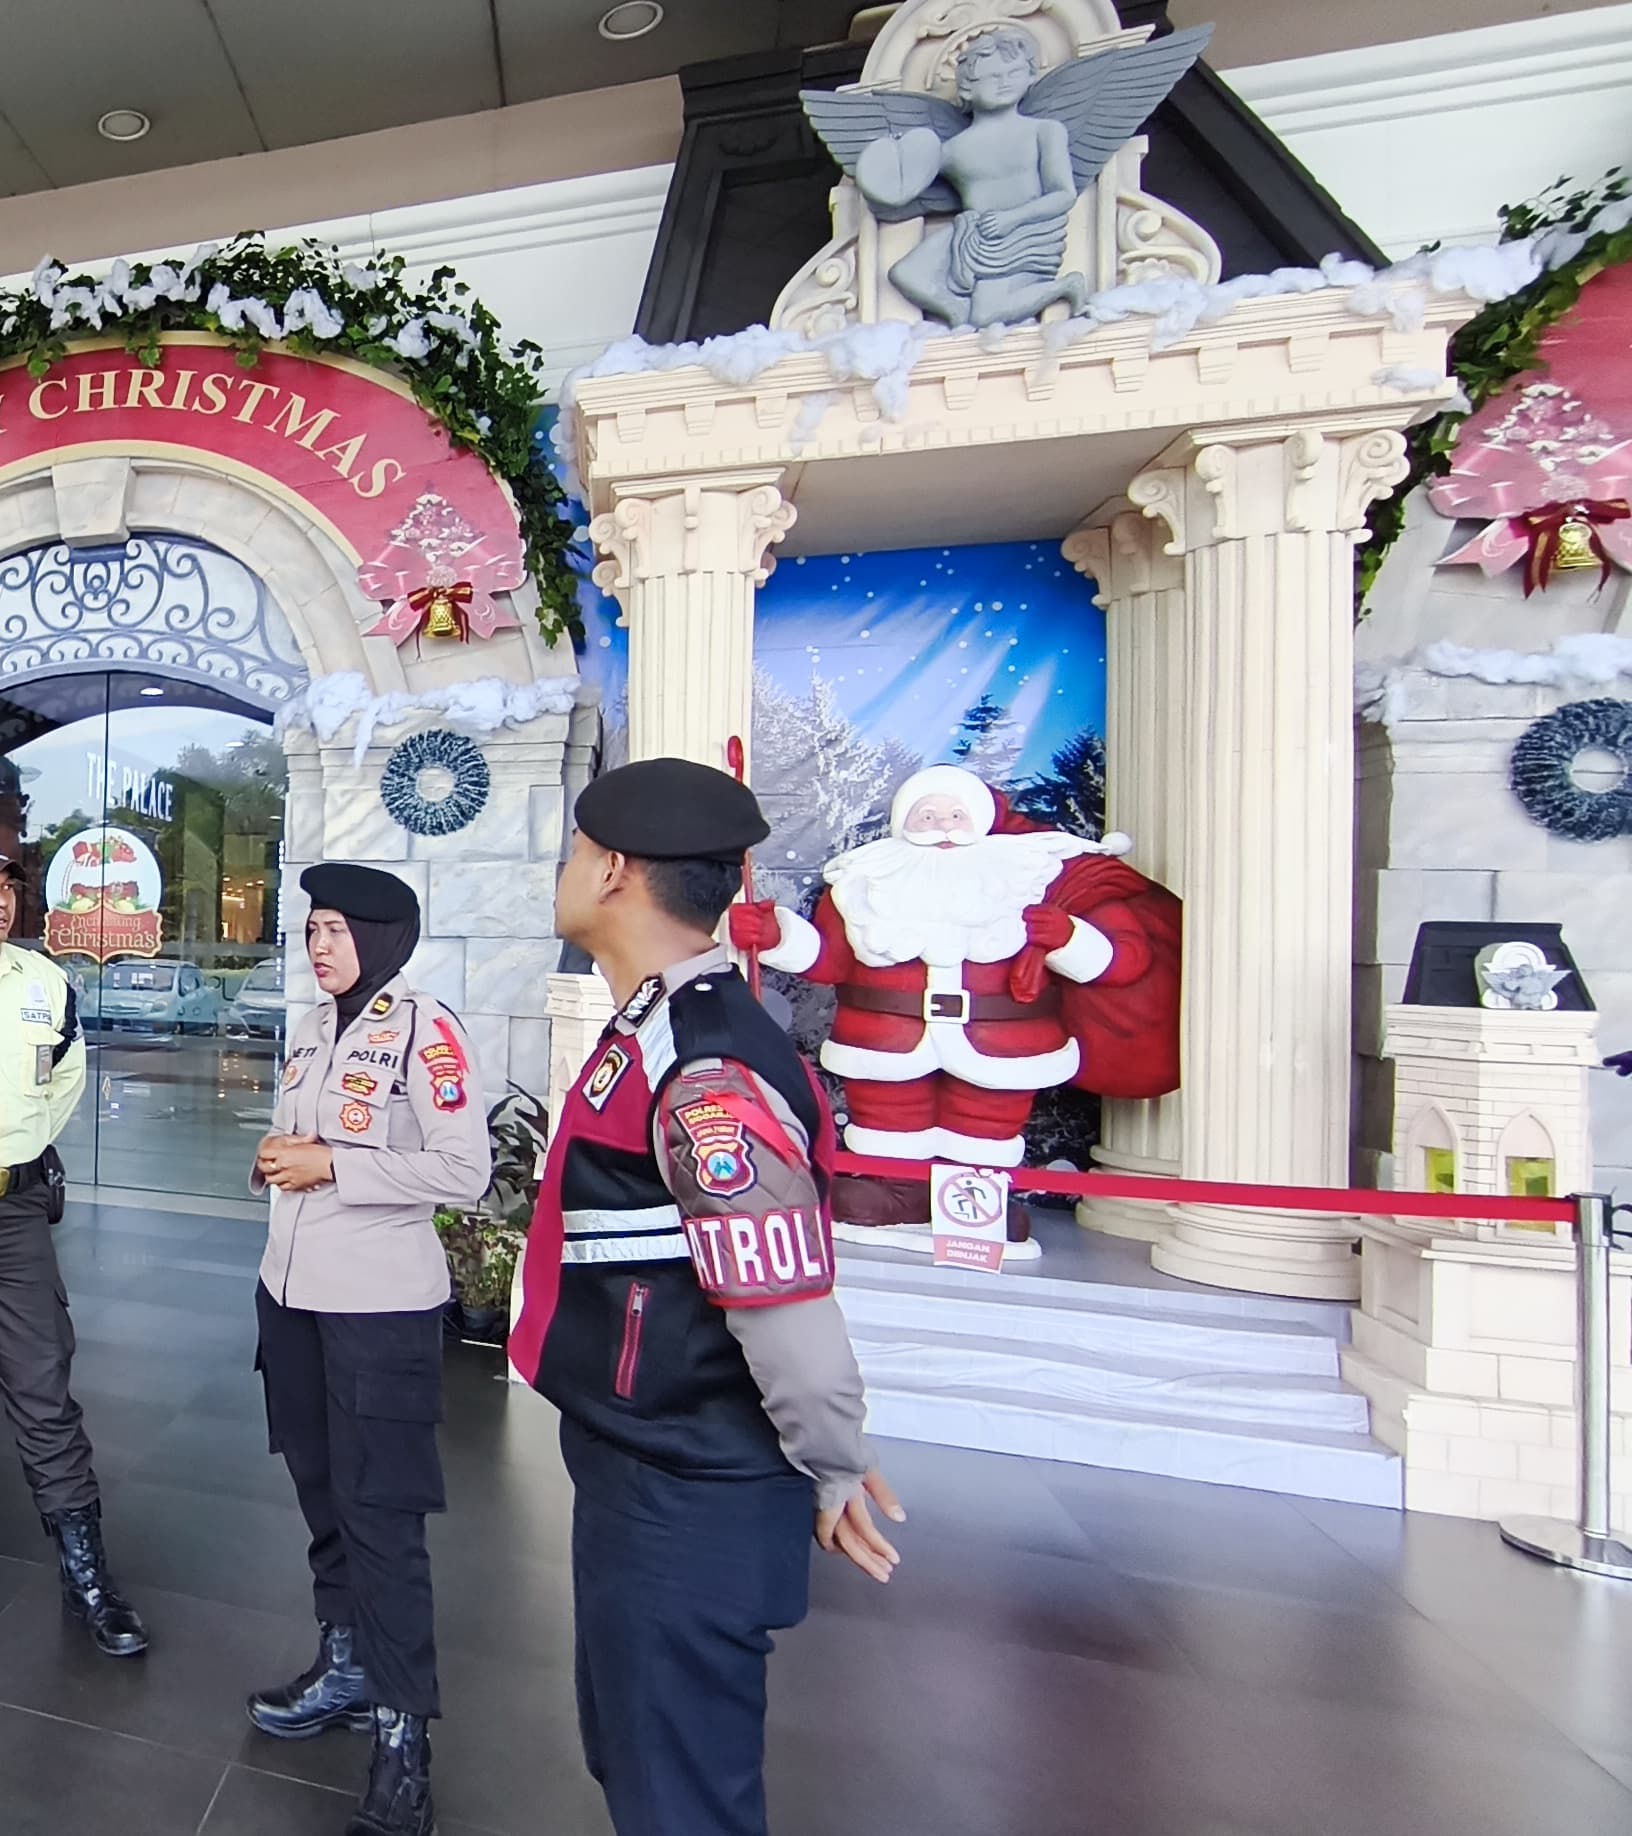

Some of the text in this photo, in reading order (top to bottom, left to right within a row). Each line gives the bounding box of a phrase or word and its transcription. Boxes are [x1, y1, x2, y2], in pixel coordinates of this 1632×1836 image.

[28, 368, 406, 499] CHRISTMAS
[87, 752, 174, 822] THE PALACE
[50, 927, 155, 949] Christmas
[347, 1050, 398, 1069] POLRI
[687, 1209, 829, 1289] ATROLI
[946, 1240, 991, 1253] JANGAN
